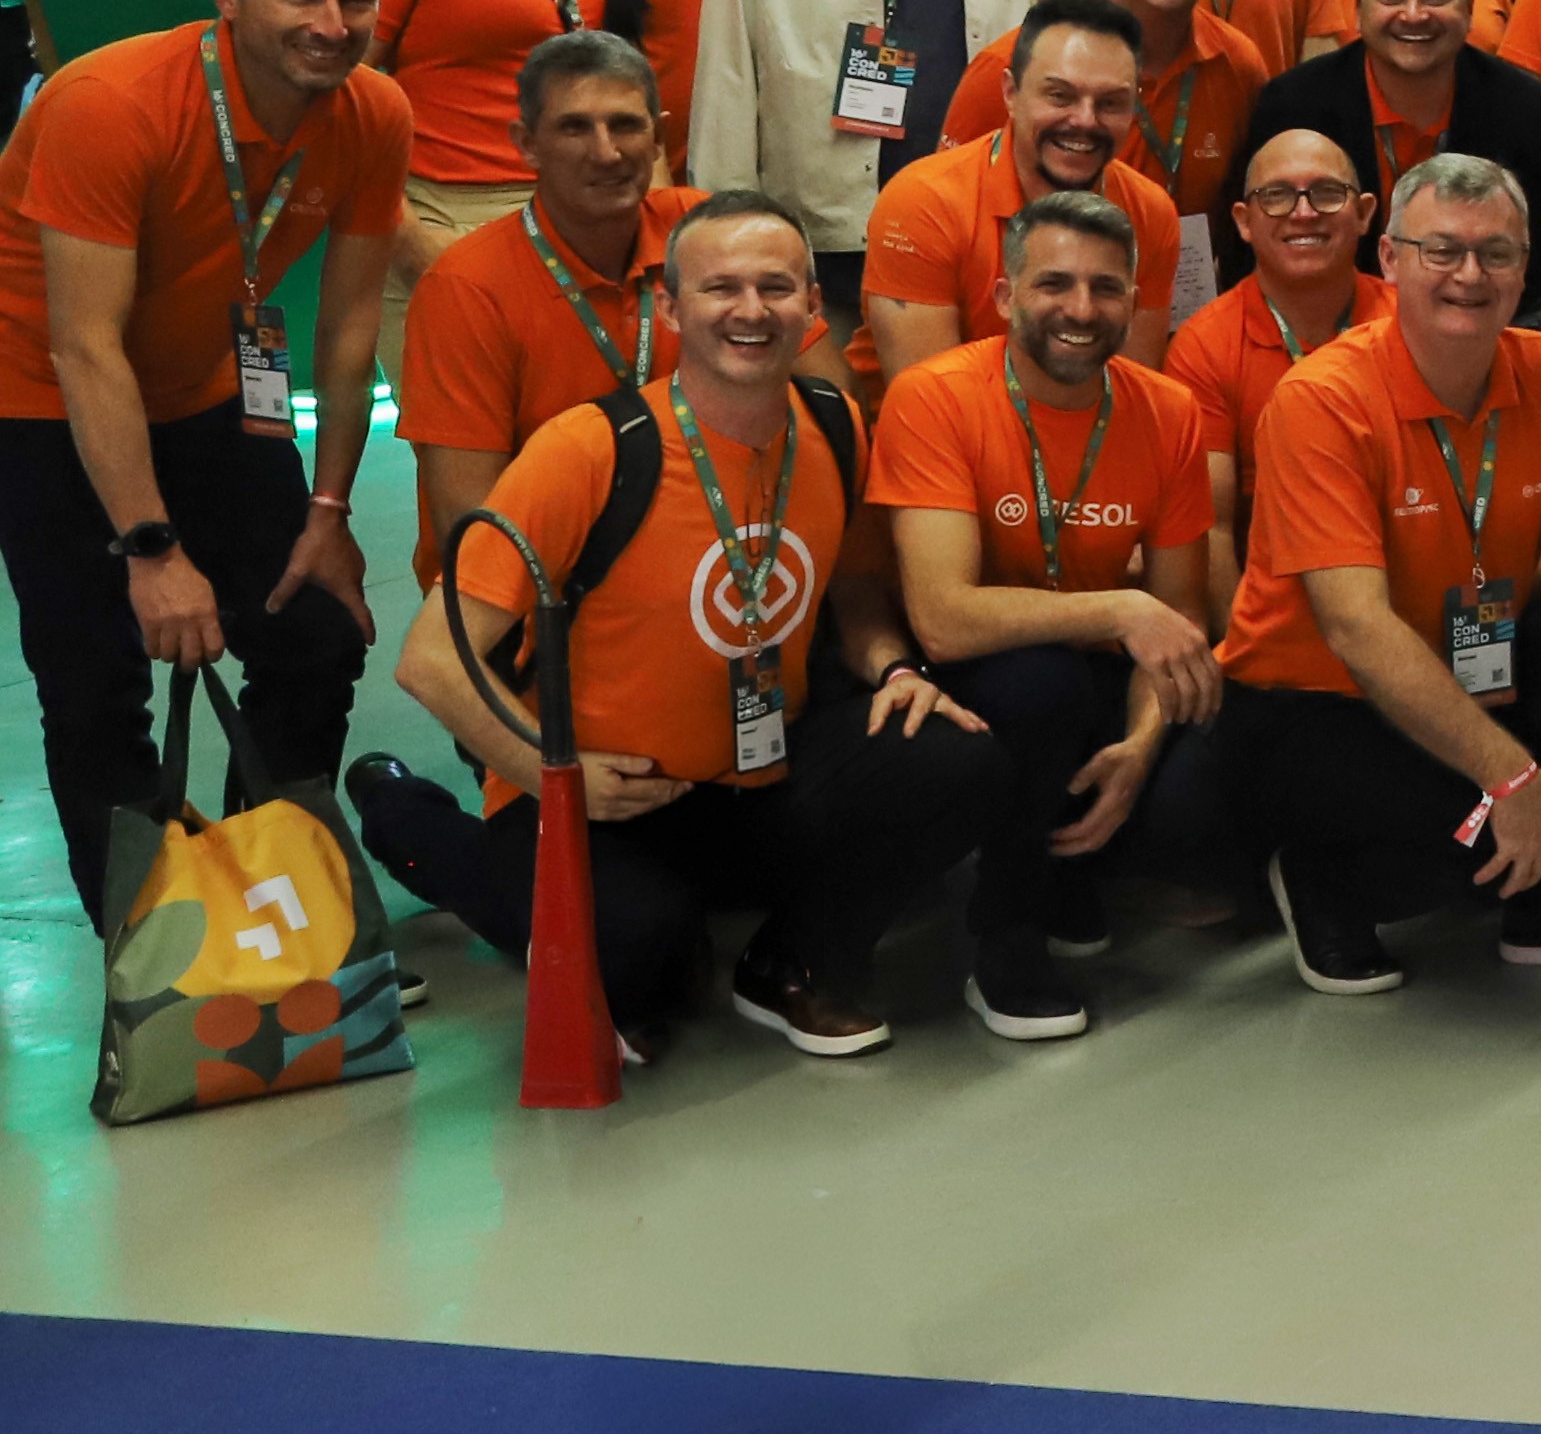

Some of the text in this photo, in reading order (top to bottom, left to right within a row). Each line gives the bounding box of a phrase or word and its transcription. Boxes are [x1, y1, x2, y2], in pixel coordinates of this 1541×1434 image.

[848, 56, 880, 70] CON
[846, 67, 888, 81] CRED
[213, 106, 236, 164] CONCRED
[1052, 498, 1140, 528] ESOL
[1452, 624, 1480, 638] CON
[1453, 633, 1490, 648] CRED
